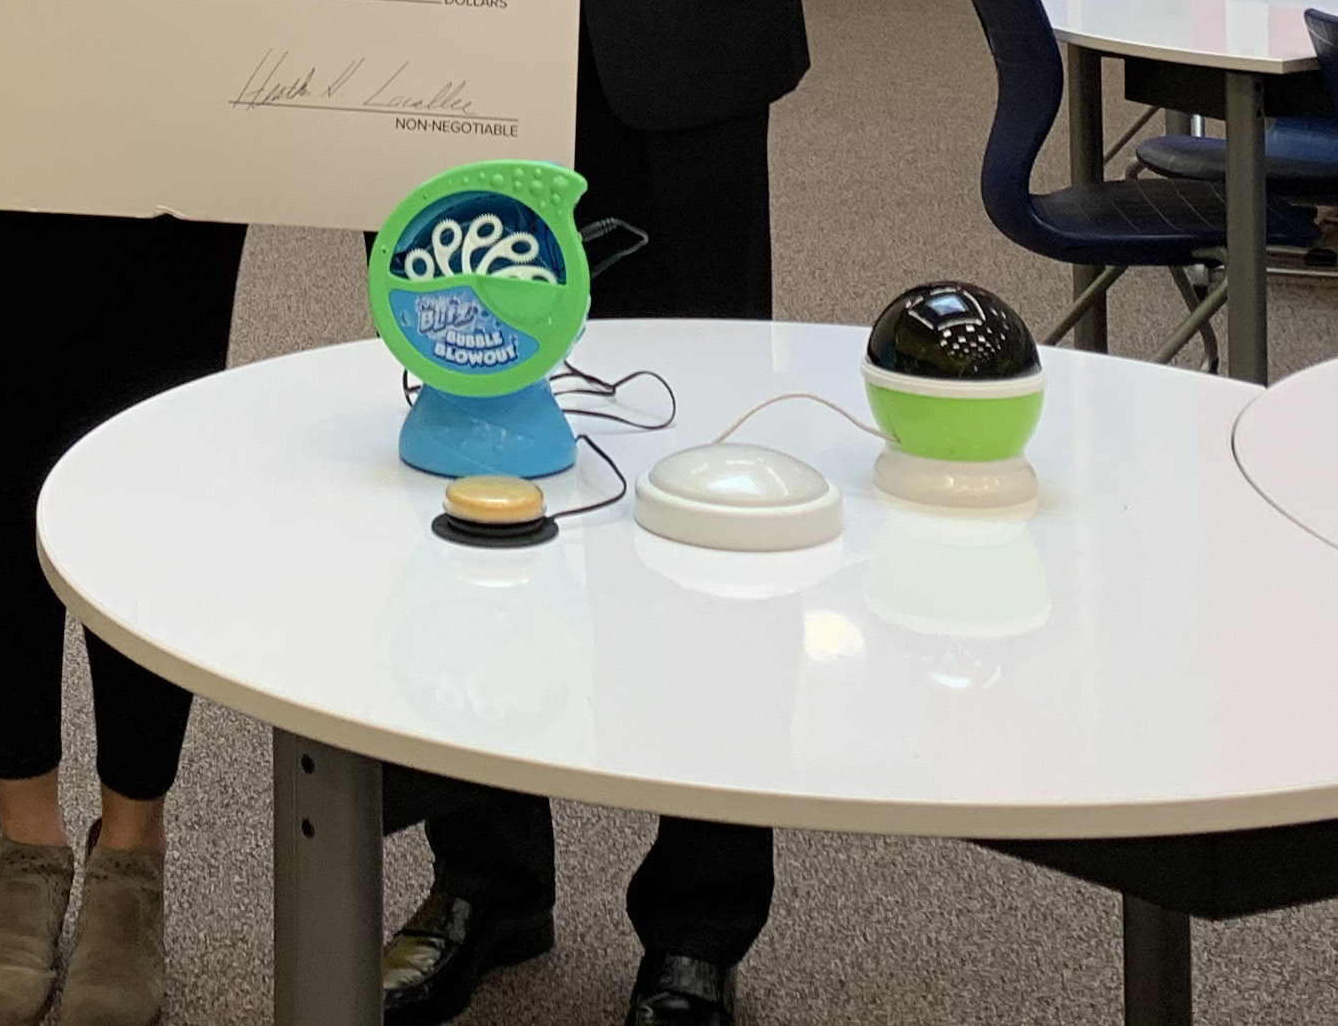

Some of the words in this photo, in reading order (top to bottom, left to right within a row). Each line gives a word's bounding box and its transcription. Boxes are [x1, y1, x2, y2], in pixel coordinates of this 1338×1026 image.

[396, 117, 518, 137] NON-NEGOTIABLE
[446, 330, 503, 350] BUBBLE
[434, 343, 518, 367] BLOWOUT
